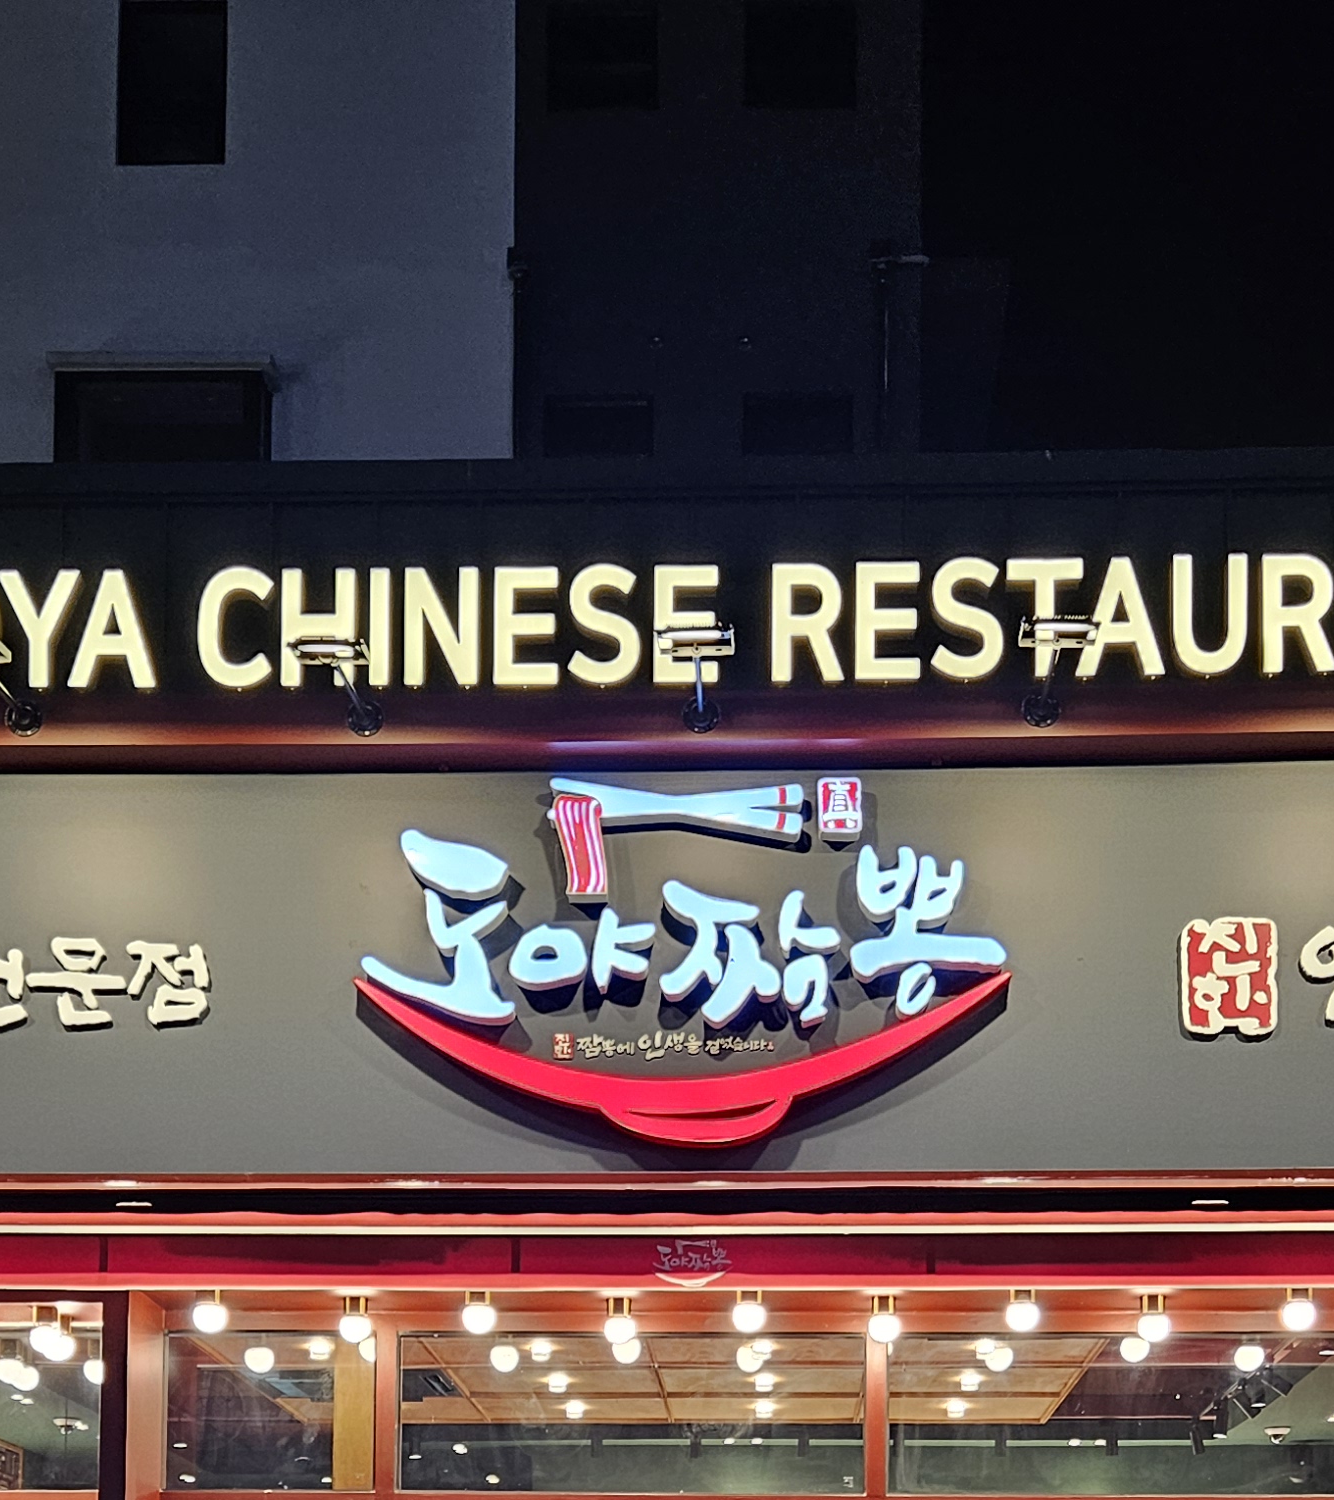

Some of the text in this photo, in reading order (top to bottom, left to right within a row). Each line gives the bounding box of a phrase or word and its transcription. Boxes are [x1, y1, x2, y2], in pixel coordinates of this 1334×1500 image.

[197, 565, 719, 690] CHINESE
[361, 828, 1009, 1027] 도야짬뽕
[576, 1033, 635, 1059] 짬뽕에
[637, 1030, 703, 1061] 인생을
